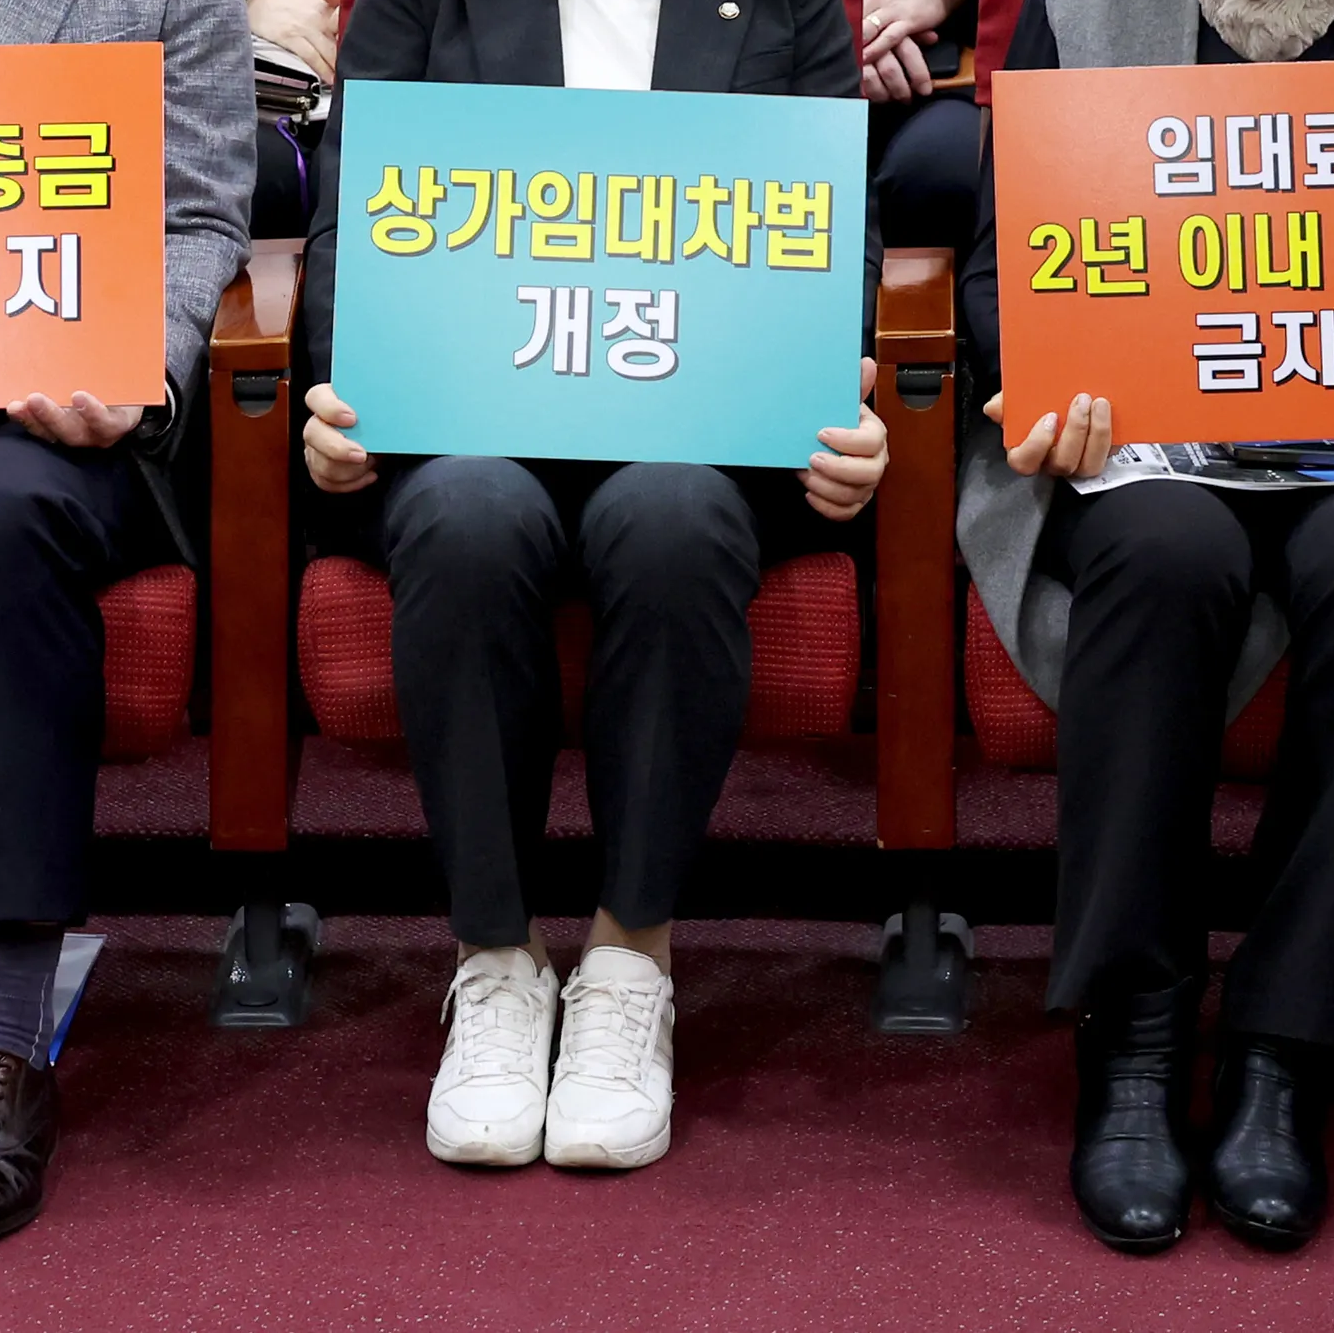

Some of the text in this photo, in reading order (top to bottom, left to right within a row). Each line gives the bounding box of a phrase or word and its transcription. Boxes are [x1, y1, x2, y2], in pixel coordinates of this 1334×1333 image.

[366, 165, 833, 272] 상가임대차법
[1028, 215, 1149, 297] 2년
[1178, 210, 1324, 291] 이내
[513, 285, 680, 381] 개정
